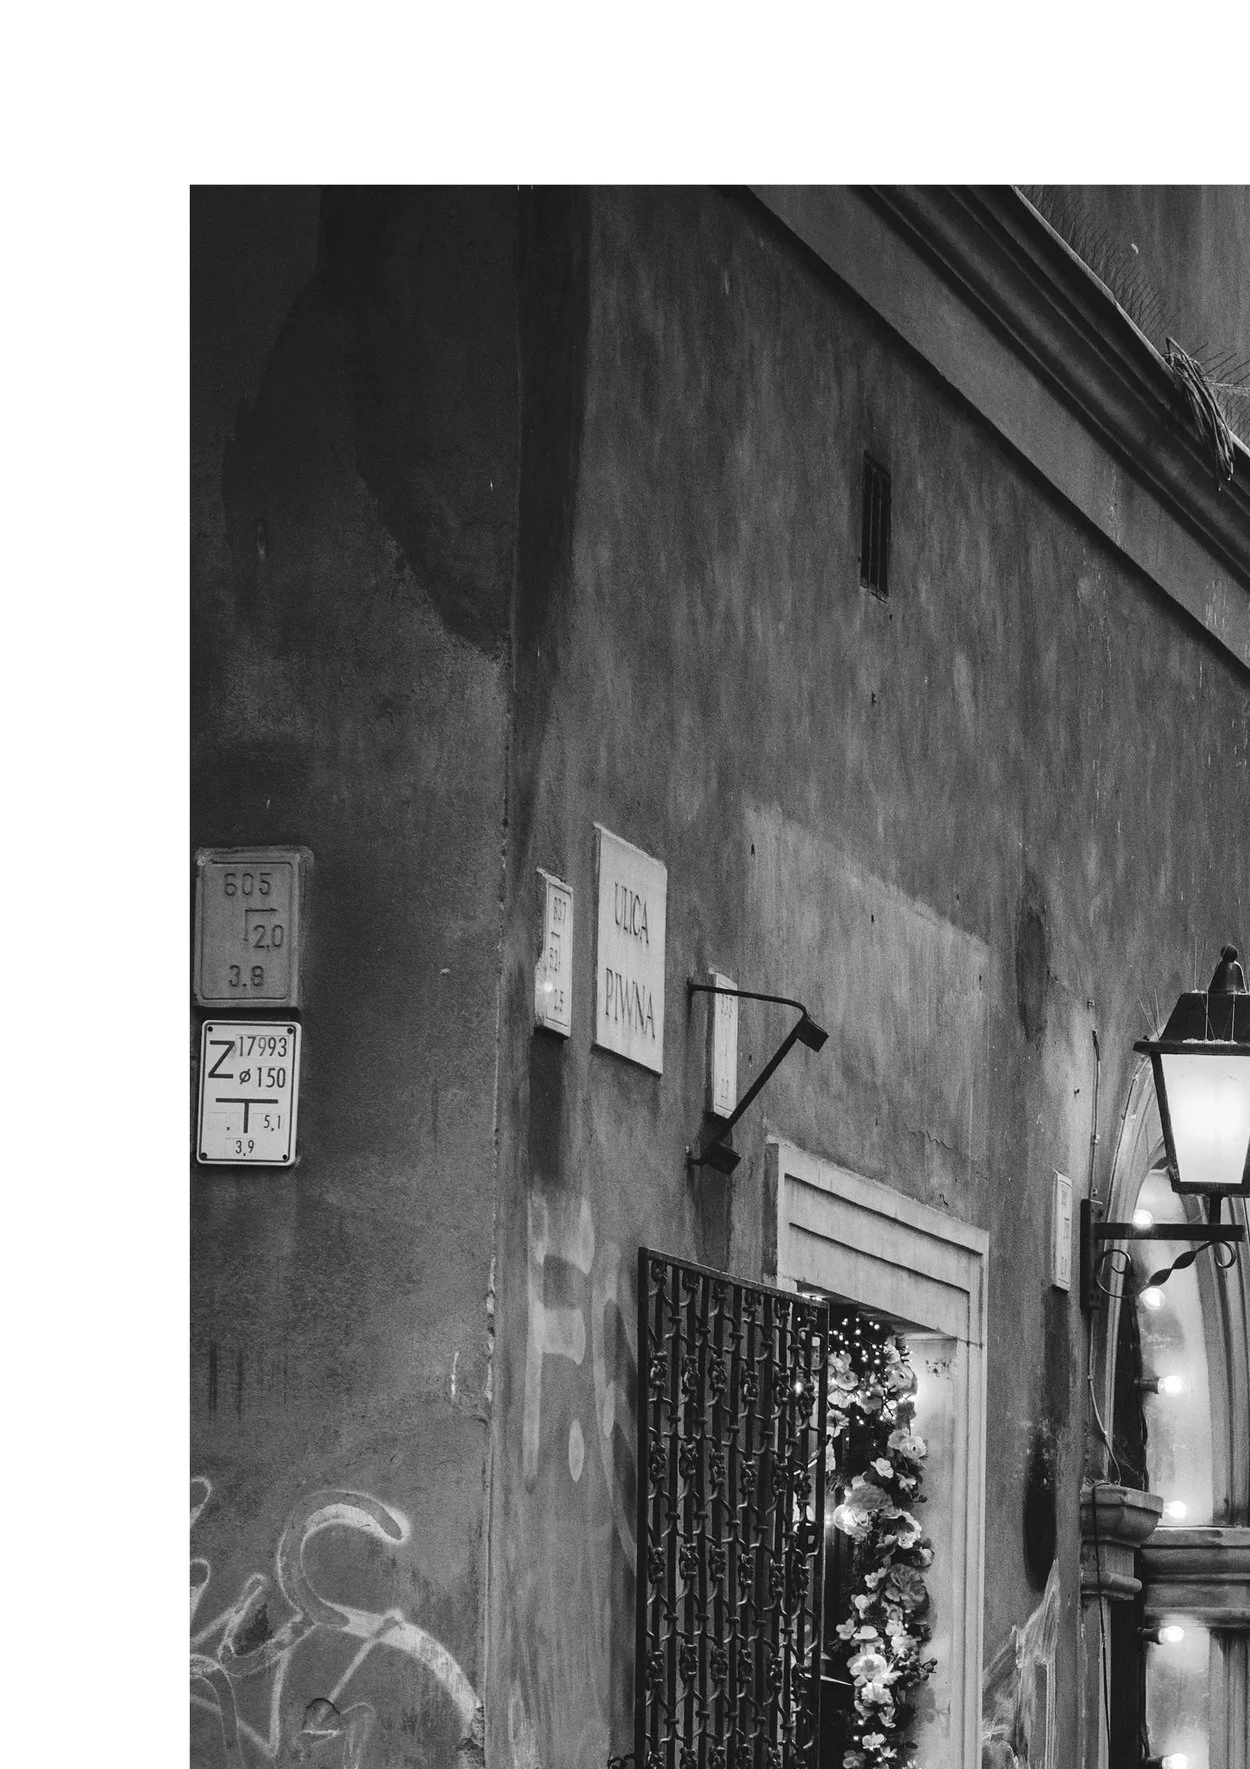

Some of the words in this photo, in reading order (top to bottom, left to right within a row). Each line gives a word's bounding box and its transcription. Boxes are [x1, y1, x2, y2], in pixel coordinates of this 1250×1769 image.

[224, 872, 271, 896] 605
[614, 881, 649, 945] ULICA
[605, 967, 656, 1039] PIWNA
[208, 1039, 235, 1079] Z
[239, 1035, 287, 1057] 17993
